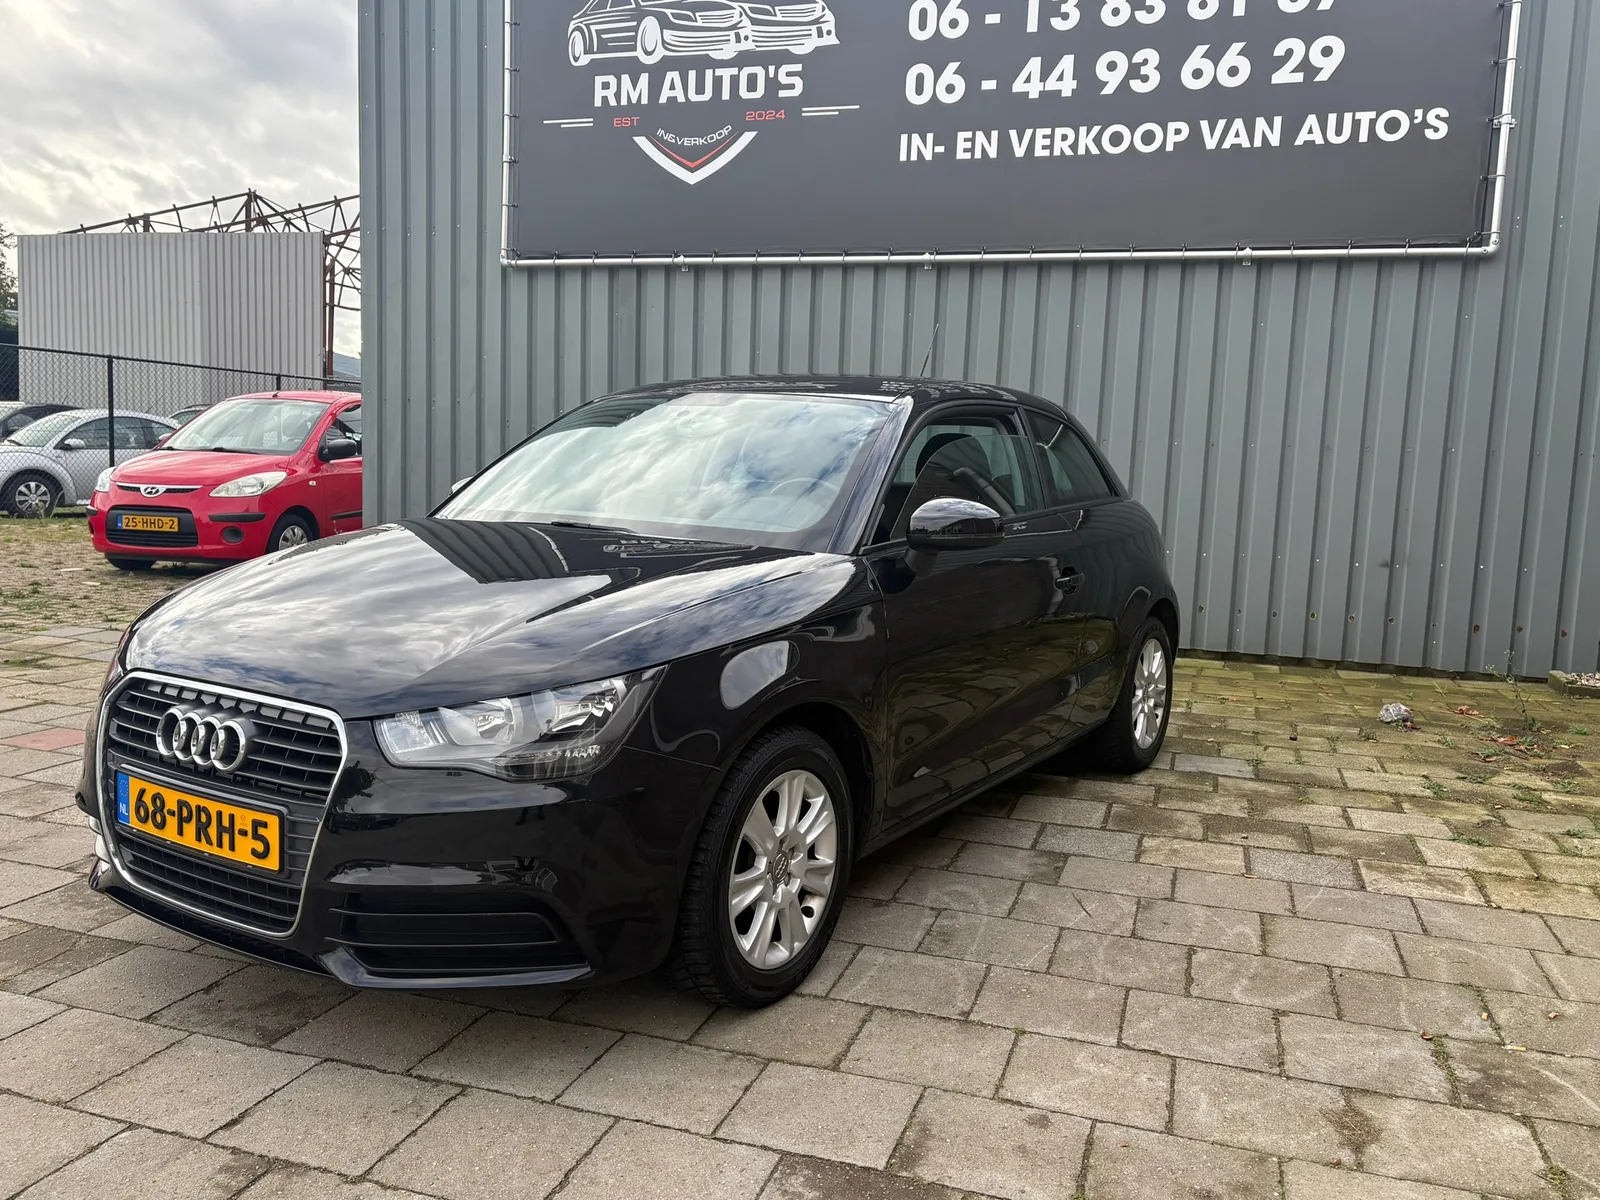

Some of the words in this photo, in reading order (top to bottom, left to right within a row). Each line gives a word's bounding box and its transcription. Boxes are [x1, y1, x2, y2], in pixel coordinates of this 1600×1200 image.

[908, 0, 970, 41] 06
[984, 13, 1001, 25] -
[1026, 0, 1081, 32] 13
[593, 73, 649, 107] RM
[658, 63, 804, 104] AUTO'S
[905, 62, 966, 105] 06
[980, 79, 997, 91] -
[1011, 55, 1078, 99] 44
[1095, 48, 1161, 95] 93
[1180, 42, 1252, 90] 66
[1270, 36, 1346, 85] 29
[613, 117, 640, 127] EST
[745, 110, 786, 121] 2024
[899, 132, 945, 162] IN-
[955, 130, 999, 160] EN
[1008, 121, 1190, 158] VERKOOP
[1199, 115, 1283, 149] VAN
[124, 517, 175, 530] 25-HHD-2
[119, 802, 129, 816] NL
[134, 787, 270, 859] 68-PRH-5
